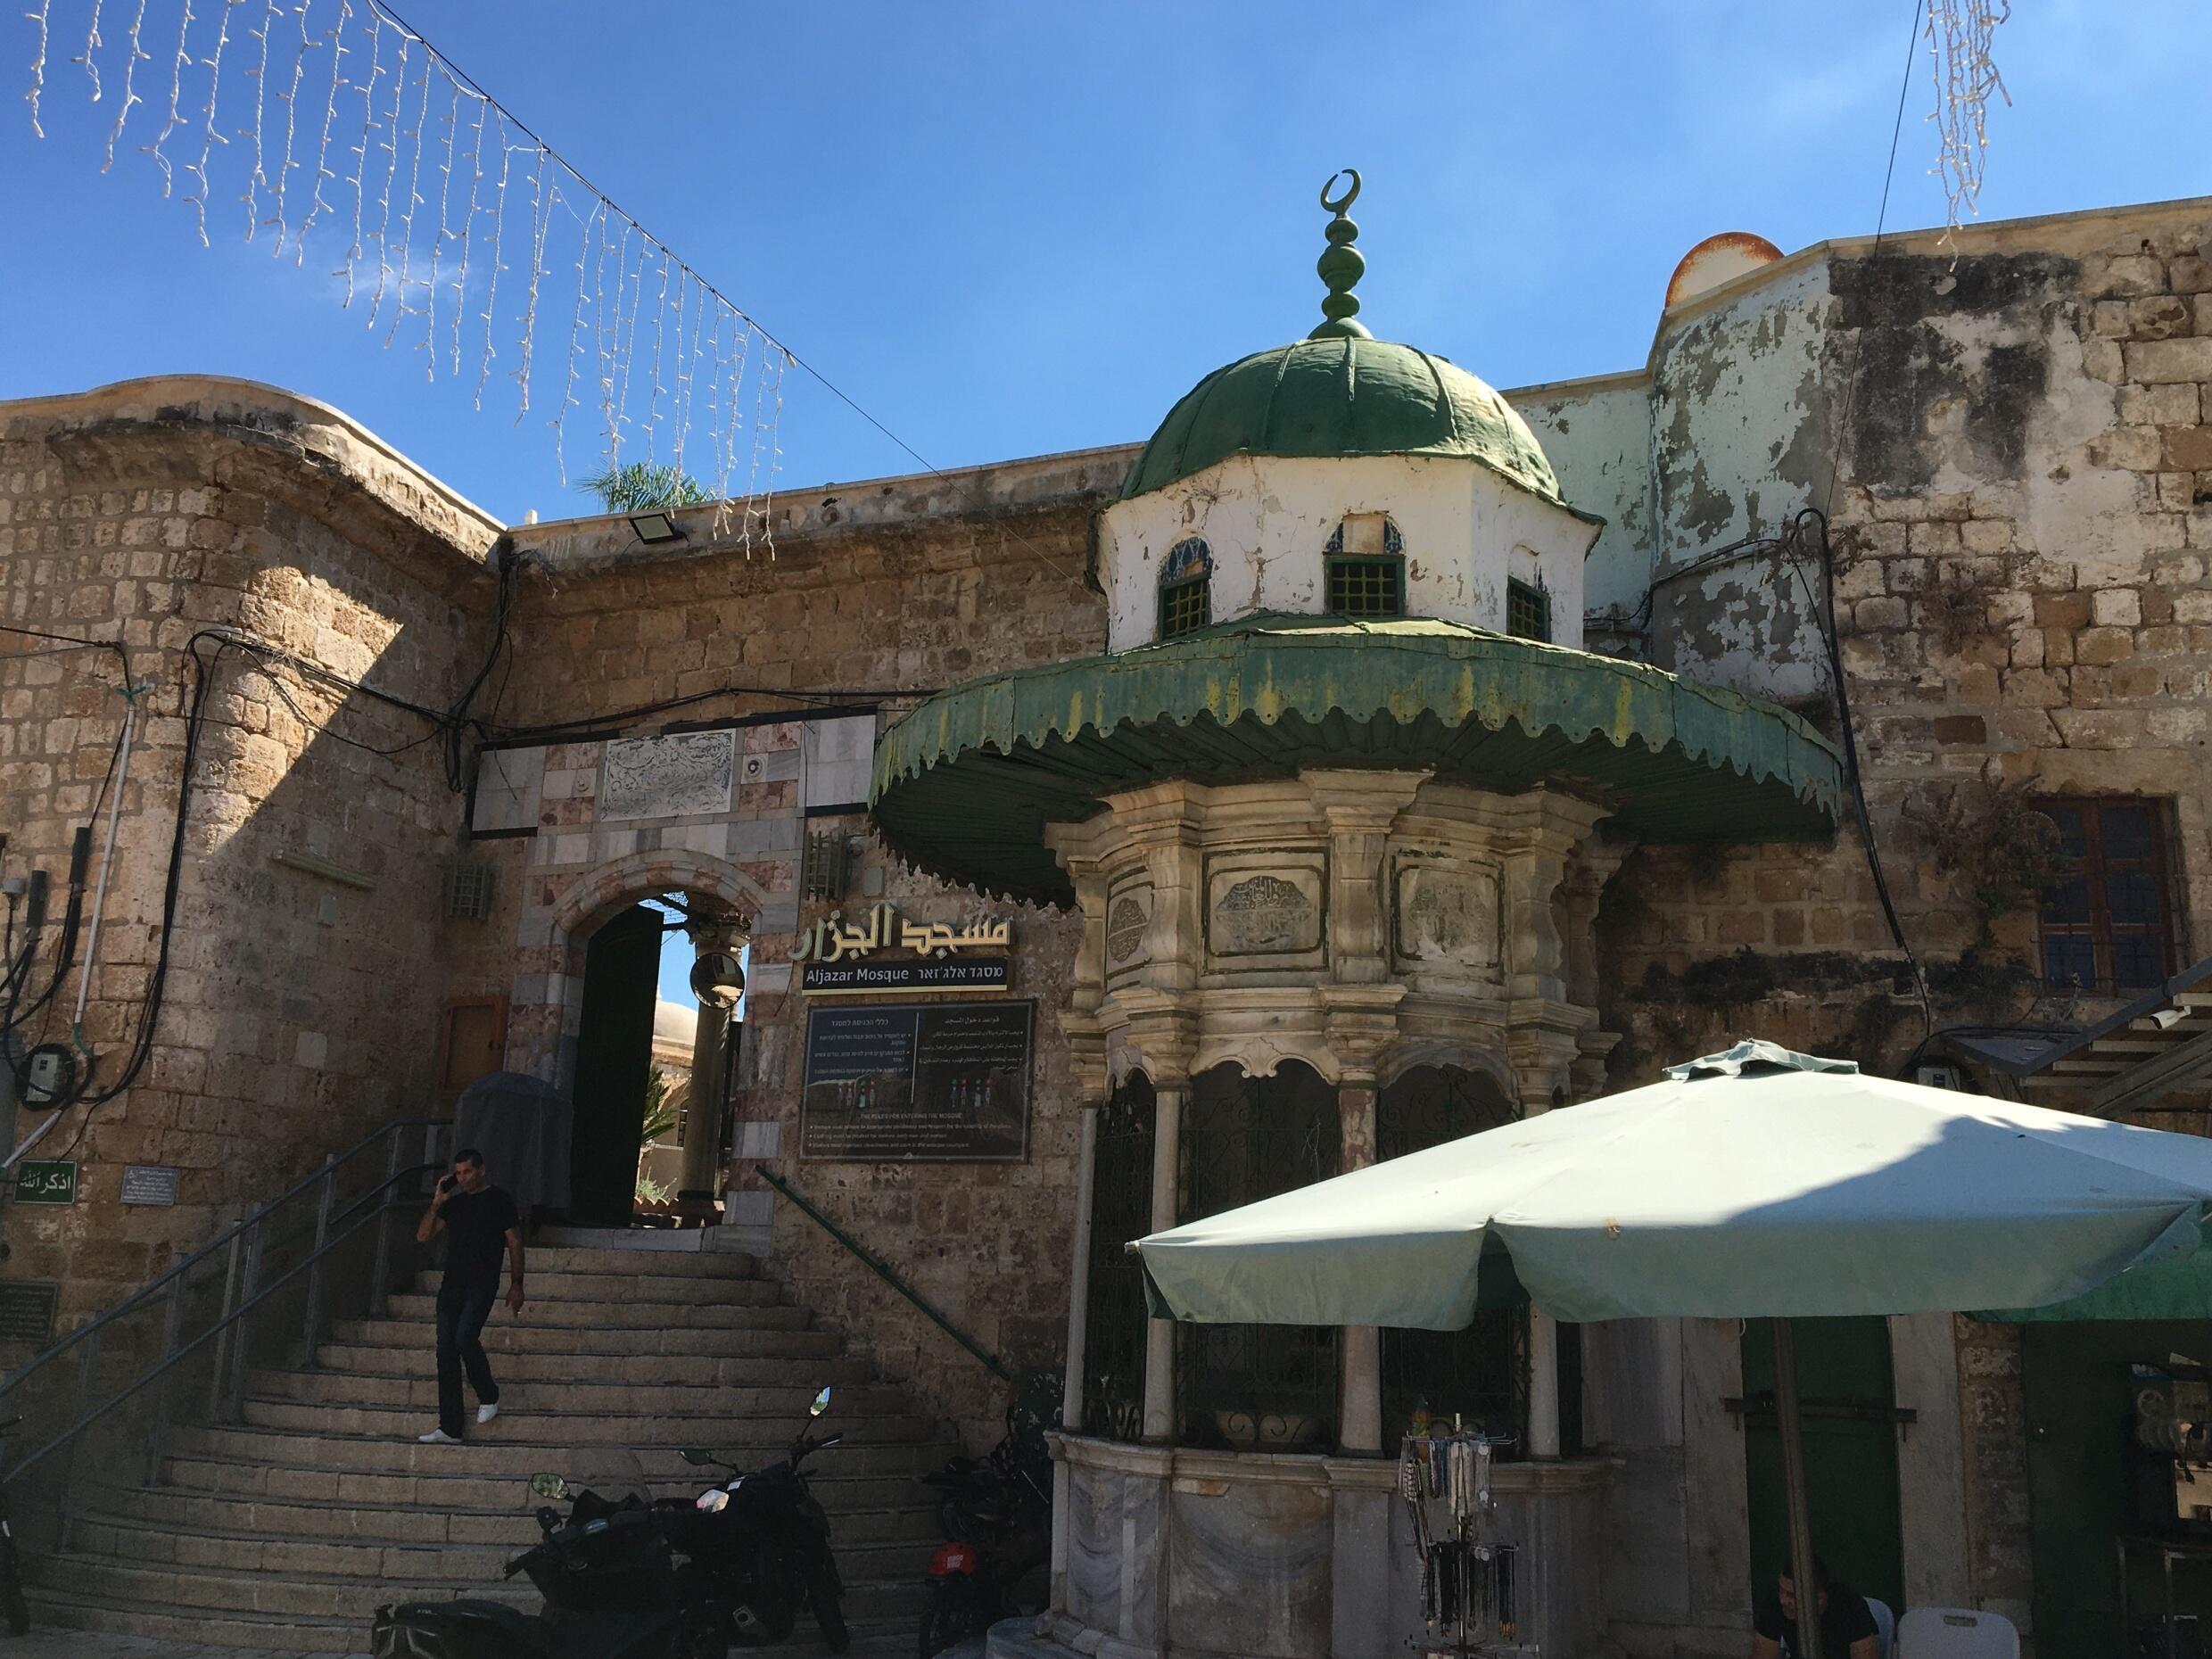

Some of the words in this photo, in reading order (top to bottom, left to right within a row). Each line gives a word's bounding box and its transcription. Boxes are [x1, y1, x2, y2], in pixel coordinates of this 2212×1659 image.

[788, 903, 895, 962] الجزار
[901, 918, 1010, 960] مسجد
[806, 969, 853, 985] Aljazar
[856, 968, 909, 984] Mosque
[970, 966, 1003, 978] מסגד
[38, 1173, 70, 1194] اذكر
